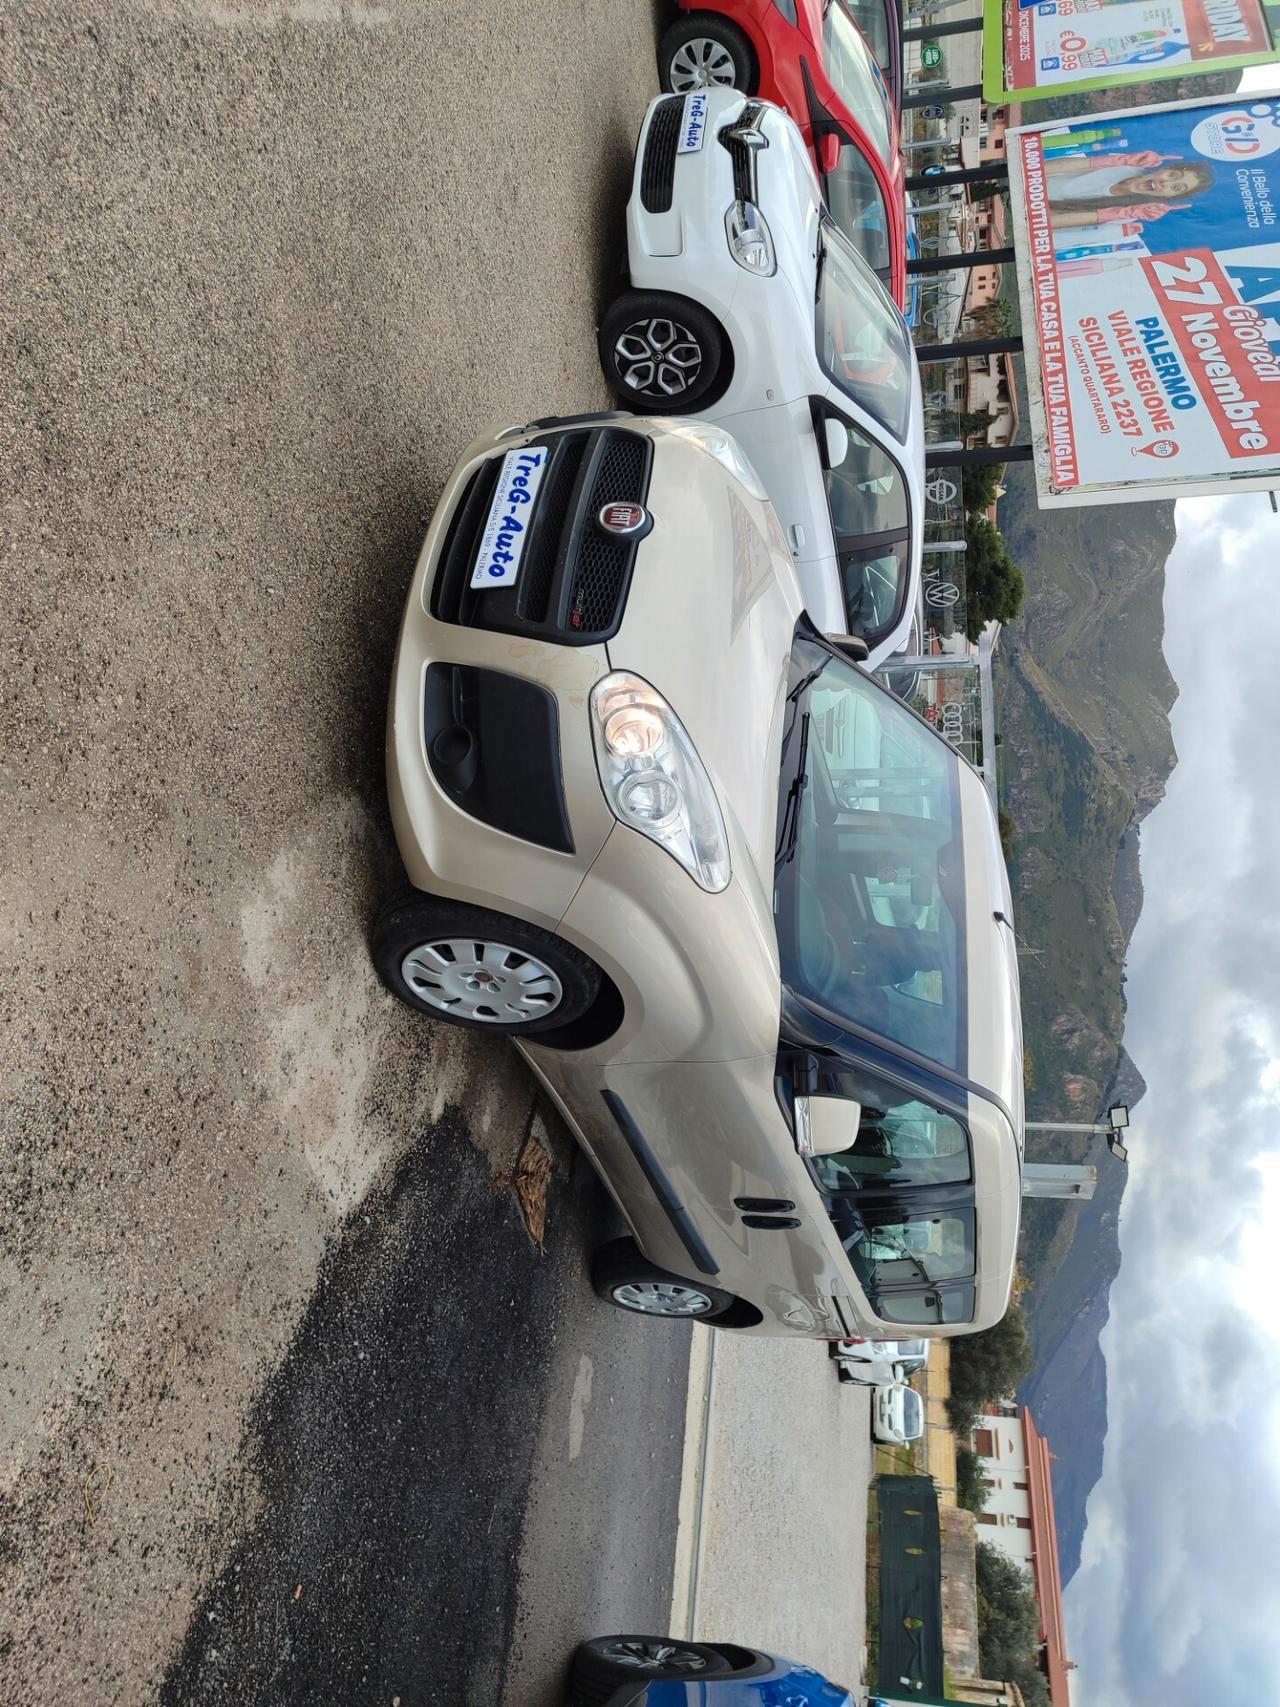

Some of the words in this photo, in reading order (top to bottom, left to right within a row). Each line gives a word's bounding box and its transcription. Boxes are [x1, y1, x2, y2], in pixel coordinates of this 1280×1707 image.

[1018, 10, 1029, 44] DICEMBRE
[1020, 44, 1030, 61] 2025
[686, 94, 706, 147] TreG-Auto
[1024, 136, 1041, 170] 10.000
[1027, 171, 1048, 228] PRODOTTI
[1235, 168, 1260, 228] Convenienza
[1252, 176, 1269, 198] Bello
[1259, 200, 1276, 225] della
[1033, 230, 1050, 254] PER
[1036, 255, 1052, 272] LA
[1038, 274, 1056, 300] TUA
[1151, 257, 1224, 305] 27
[1040, 301, 1058, 340] CASA
[1044, 341, 1060, 351] E
[1045, 352, 1062, 370] LA
[1078, 316, 1125, 398] SICILIANA
[1110, 399, 1143, 437] 2237
[1107, 310, 1142, 357] VIALE
[1126, 358, 1175, 433] REGIONE
[1135, 317, 1197, 410] PALERMO
[1047, 374, 1066, 405] TUA
[1068, 335, 1090, 374] (ACCANTO
[1082, 376, 1112, 434] QUARTARARO)
[1181, 312, 1269, 450] Novembre
[1051, 407, 1075, 483] FAMIGLIA
[506, 456, 514, 470] VIALE
[498, 470, 510, 494] REGIONE
[488, 454, 541, 578] TreG-Auto
[490, 495, 504, 521] SICILIANA
[610, 508, 632, 526] FIAT
[475, 552, 488, 580] PALERMO
